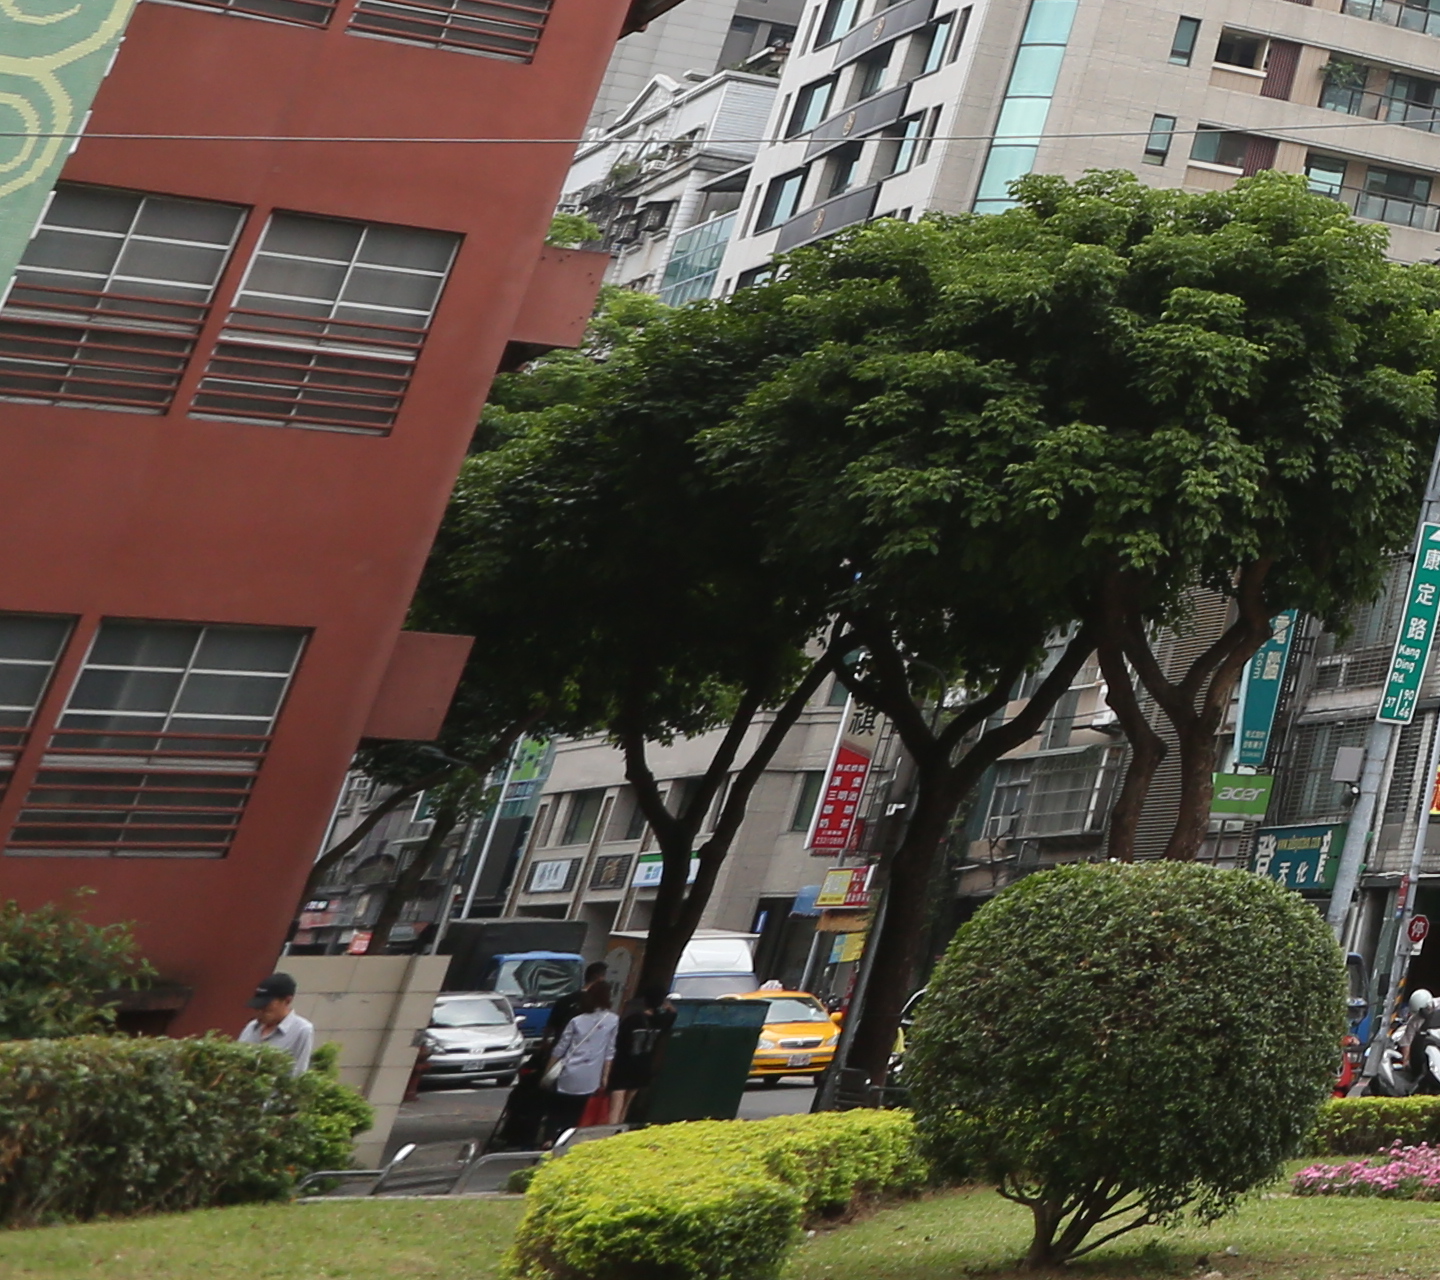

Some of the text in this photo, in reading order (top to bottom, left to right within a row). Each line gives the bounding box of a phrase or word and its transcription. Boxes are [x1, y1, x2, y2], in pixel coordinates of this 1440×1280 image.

[1398, 644, 1421, 660] Kang
[1395, 659, 1415, 673] Ding
[1391, 672, 1405, 684] Rd.
[1385, 696, 1397, 708] 37
[1218, 787, 1266, 801] acer
